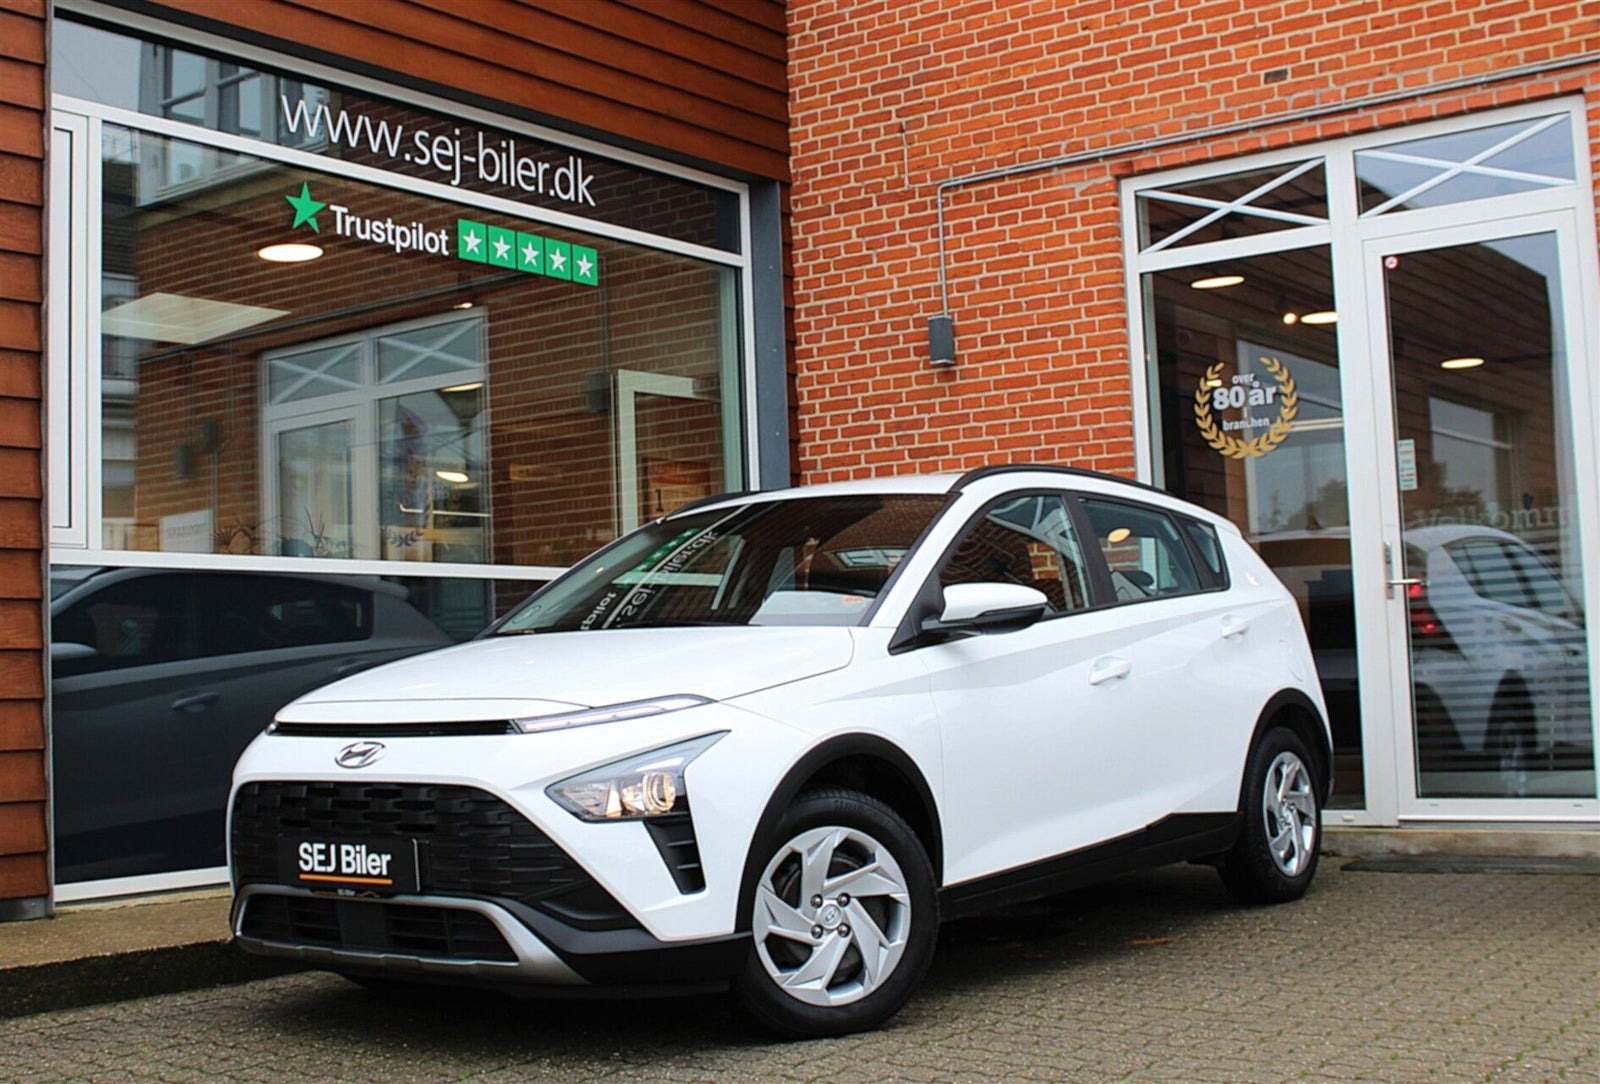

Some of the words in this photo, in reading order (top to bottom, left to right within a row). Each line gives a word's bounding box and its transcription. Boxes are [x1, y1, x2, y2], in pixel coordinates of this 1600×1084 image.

[281, 94, 596, 207] www.sej-biler.dk
[329, 204, 449, 256] Trustpilot
[1232, 374, 1255, 384] over
[1213, 385, 1245, 410] 80
[1248, 381, 1277, 406] år
[1222, 417, 1270, 431] branchen
[298, 842, 336, 873] SEJ
[340, 844, 391, 876] Biler
